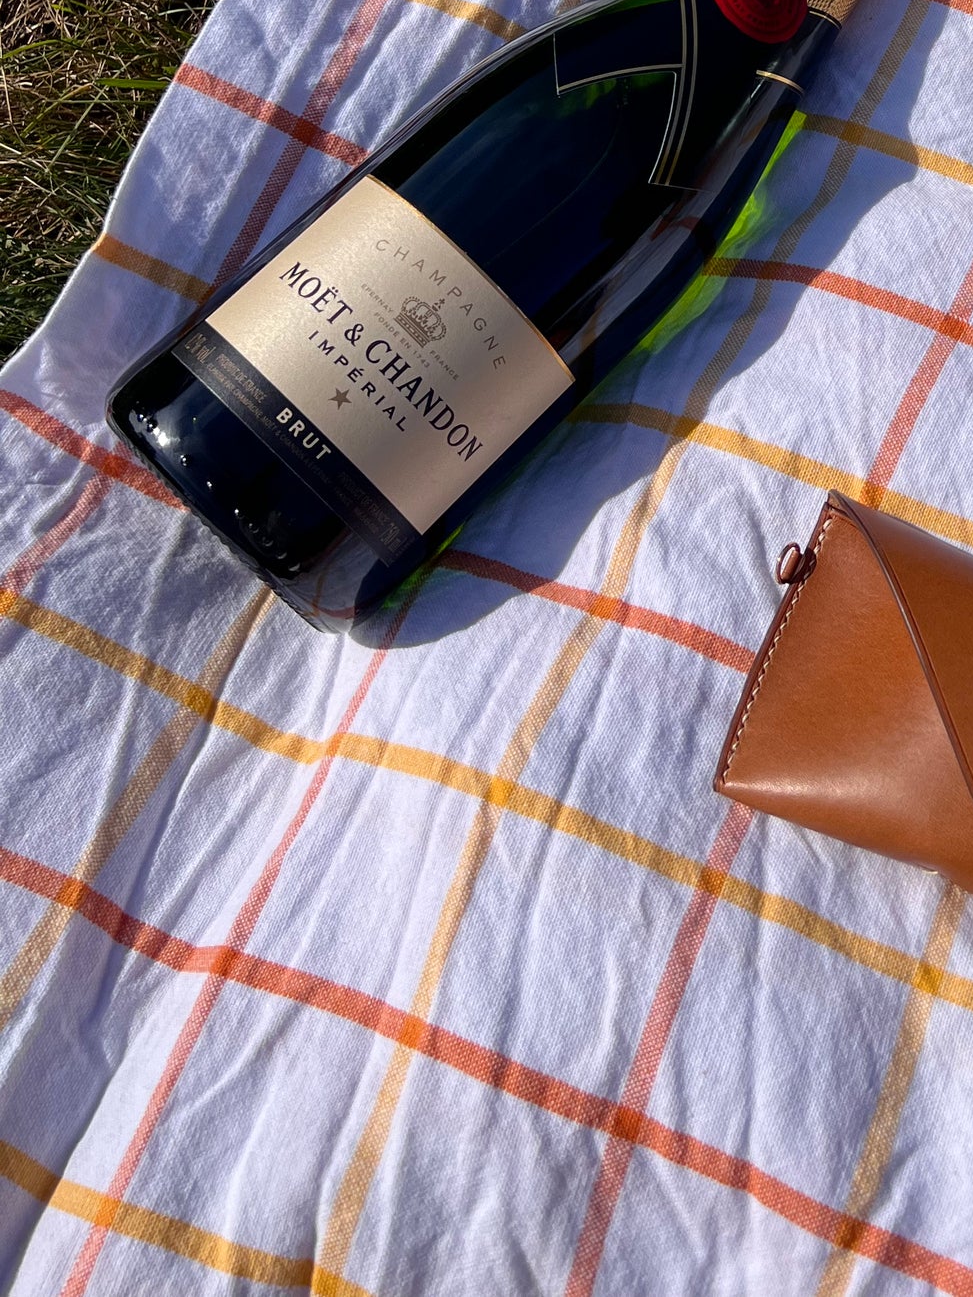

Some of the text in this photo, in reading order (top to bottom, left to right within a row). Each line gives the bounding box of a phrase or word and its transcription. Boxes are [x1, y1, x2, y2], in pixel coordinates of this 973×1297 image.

[375, 238, 508, 371] CHAMPAGNE
[280, 261, 484, 463] MOËT & CHANDON
[308, 330, 407, 432] IMPÉRIAL
[401, 335, 414, 354] EN
[412, 347, 431, 370] 1743
[429, 350, 460, 381] FRANCE
[276, 407, 332, 461] BRUT
